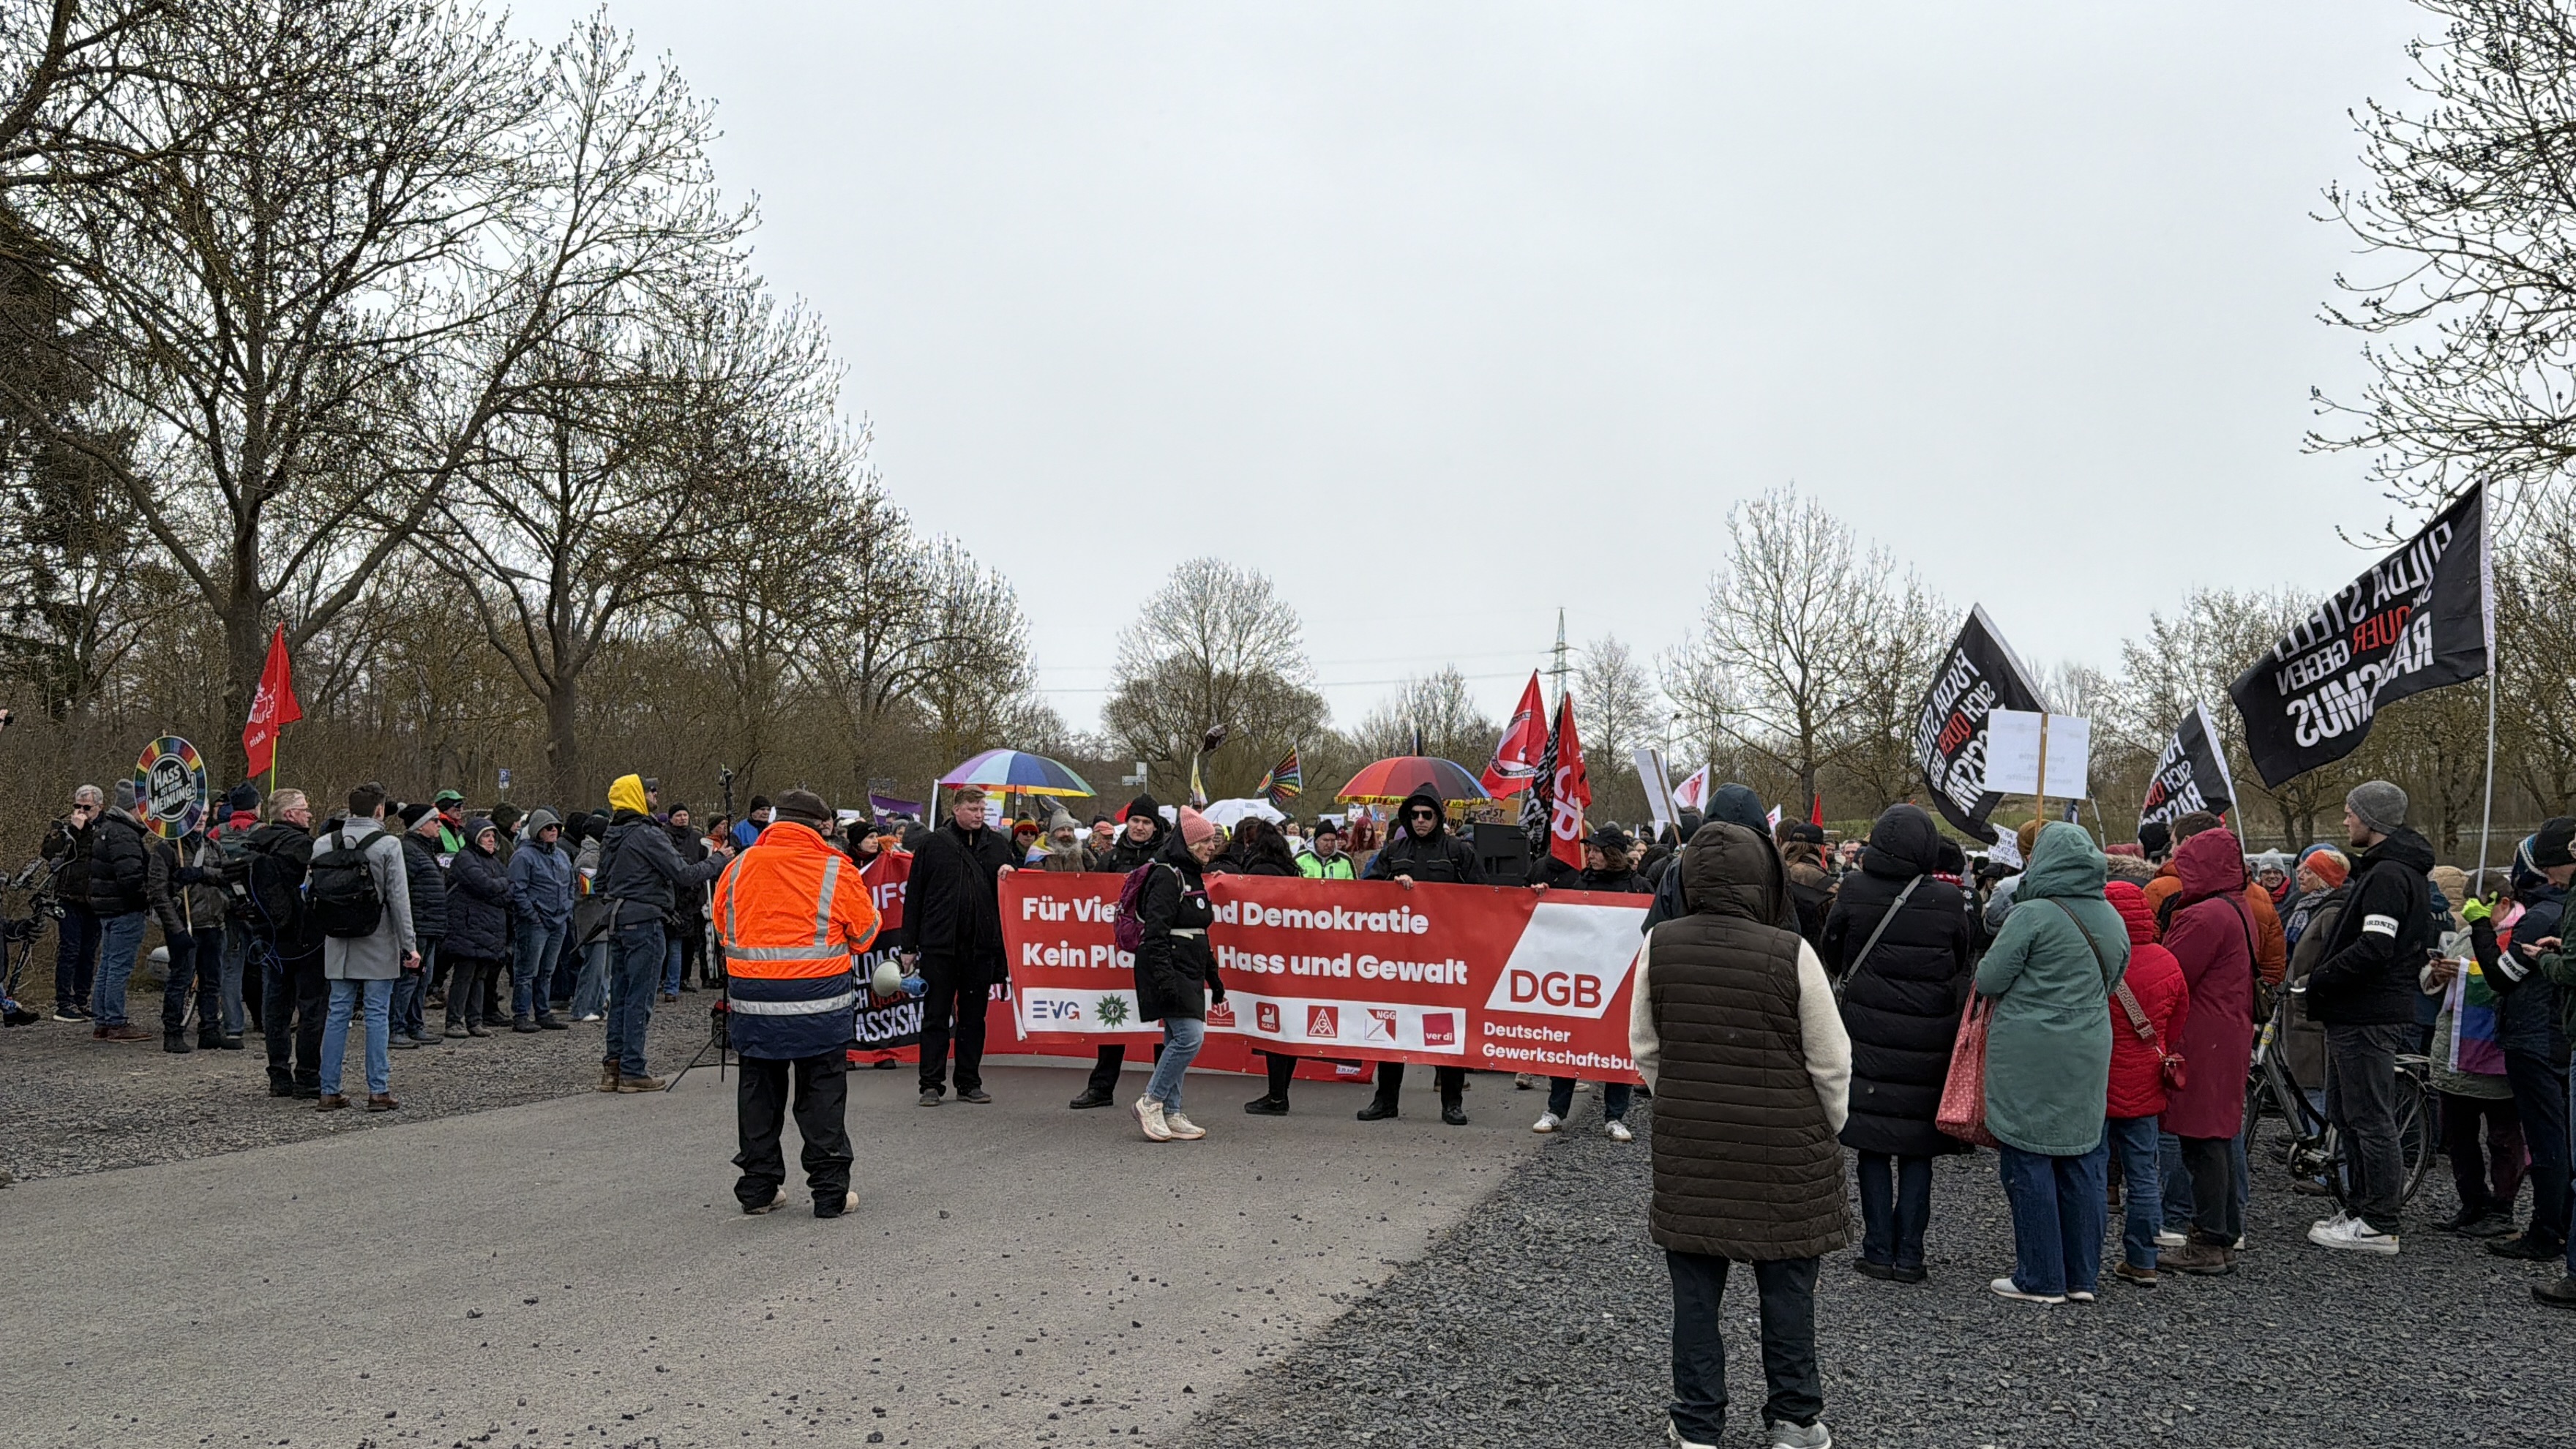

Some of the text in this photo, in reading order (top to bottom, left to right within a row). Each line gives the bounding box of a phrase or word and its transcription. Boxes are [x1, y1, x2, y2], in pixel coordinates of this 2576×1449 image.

[154, 765, 181, 790] HASS
[149, 774, 195, 817] MEINUNG!
[1022, 896, 1070, 922] Für
[1213, 900, 1238, 925] nd
[1243, 902, 1429, 935] Demokratie
[1023, 940, 1467, 985] Kein Pla Hass und Gewalt
[1510, 969, 1602, 1008] DGB
[1033, 1000, 1080, 1020] EVG
[1377, 1011, 1396, 1019] NGG
[1483, 1022, 1570, 1043] Deutscher
[1483, 1043, 1639, 1071] Gewerkschaftsbu
